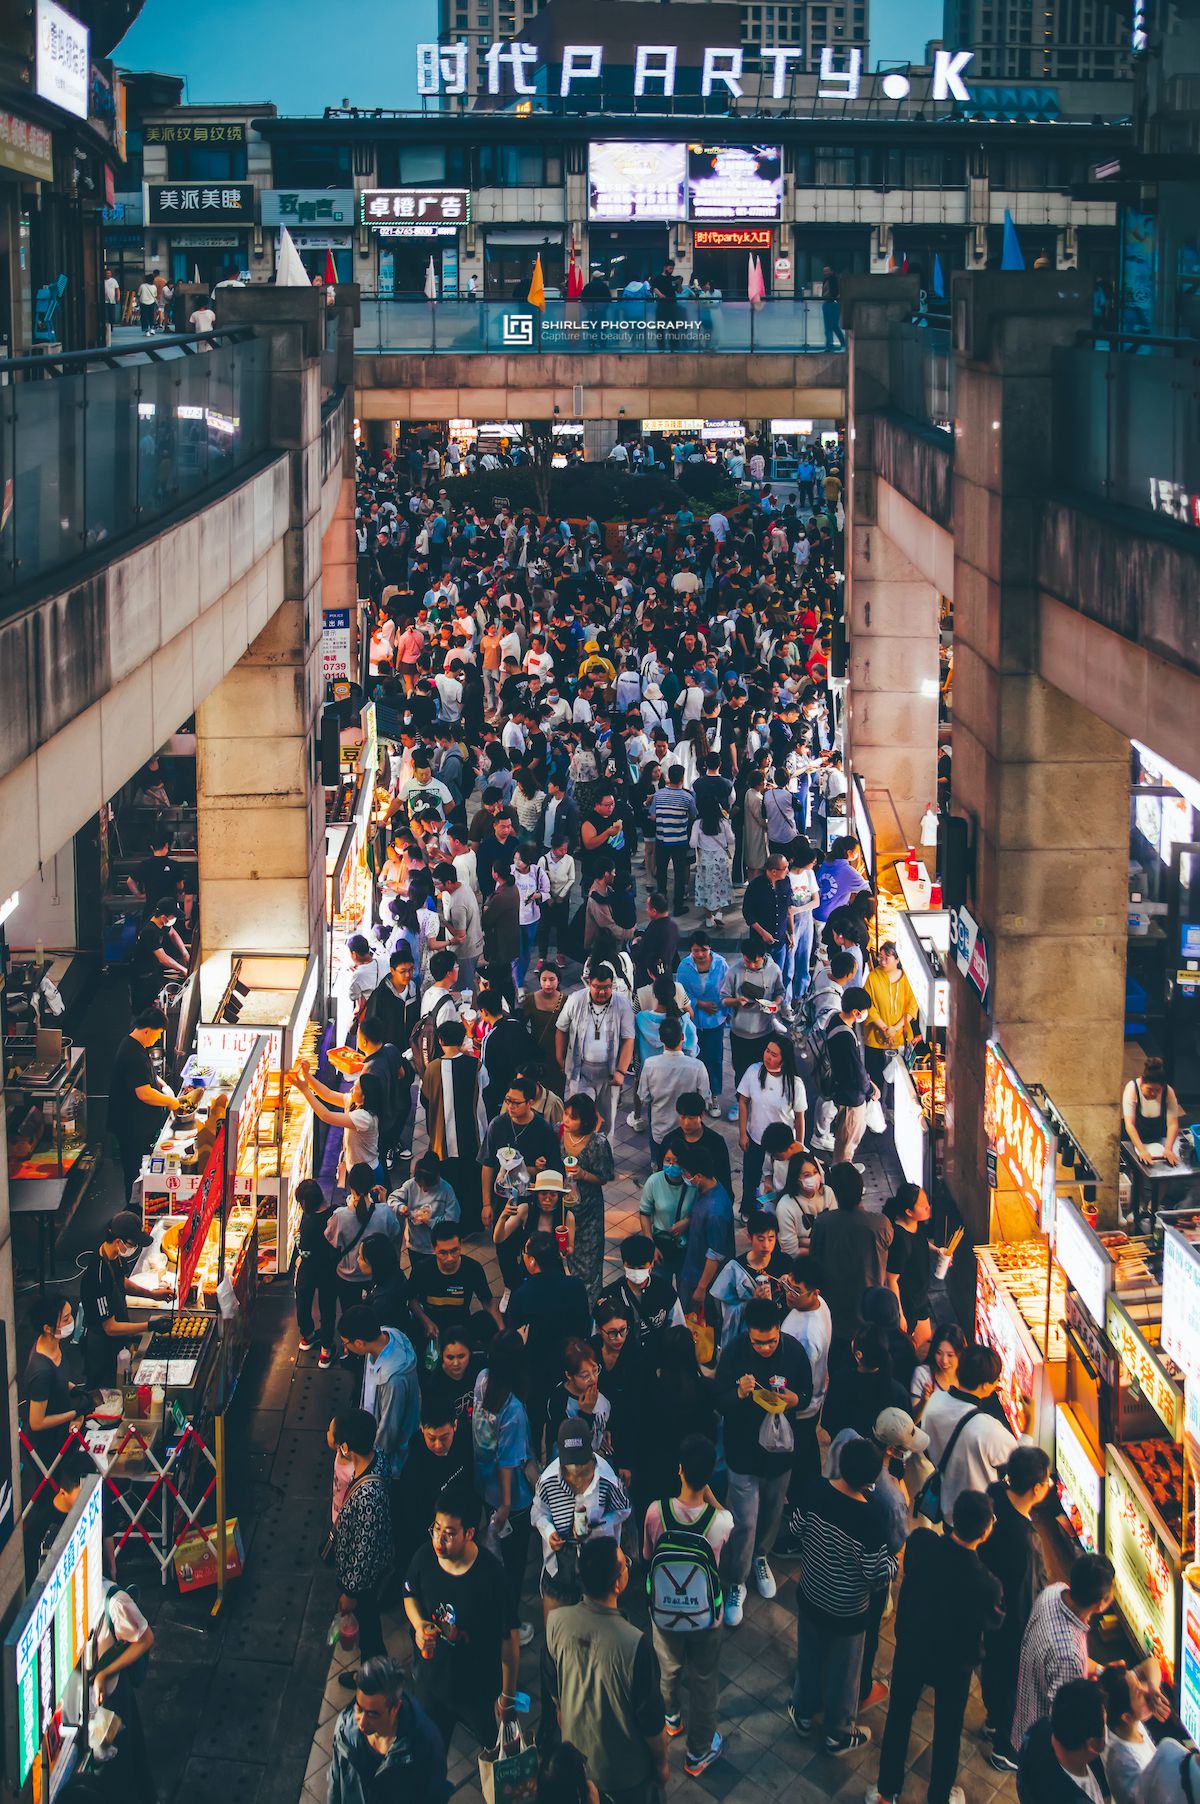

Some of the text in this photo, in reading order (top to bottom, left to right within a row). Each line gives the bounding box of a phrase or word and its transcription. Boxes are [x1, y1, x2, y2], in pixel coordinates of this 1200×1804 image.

[146, 127, 242, 142] 美派纹身纹绣
[368, 196, 462, 218] 卓橙广告
[1121, 1325, 1175, 1426] 烤猪蹄
